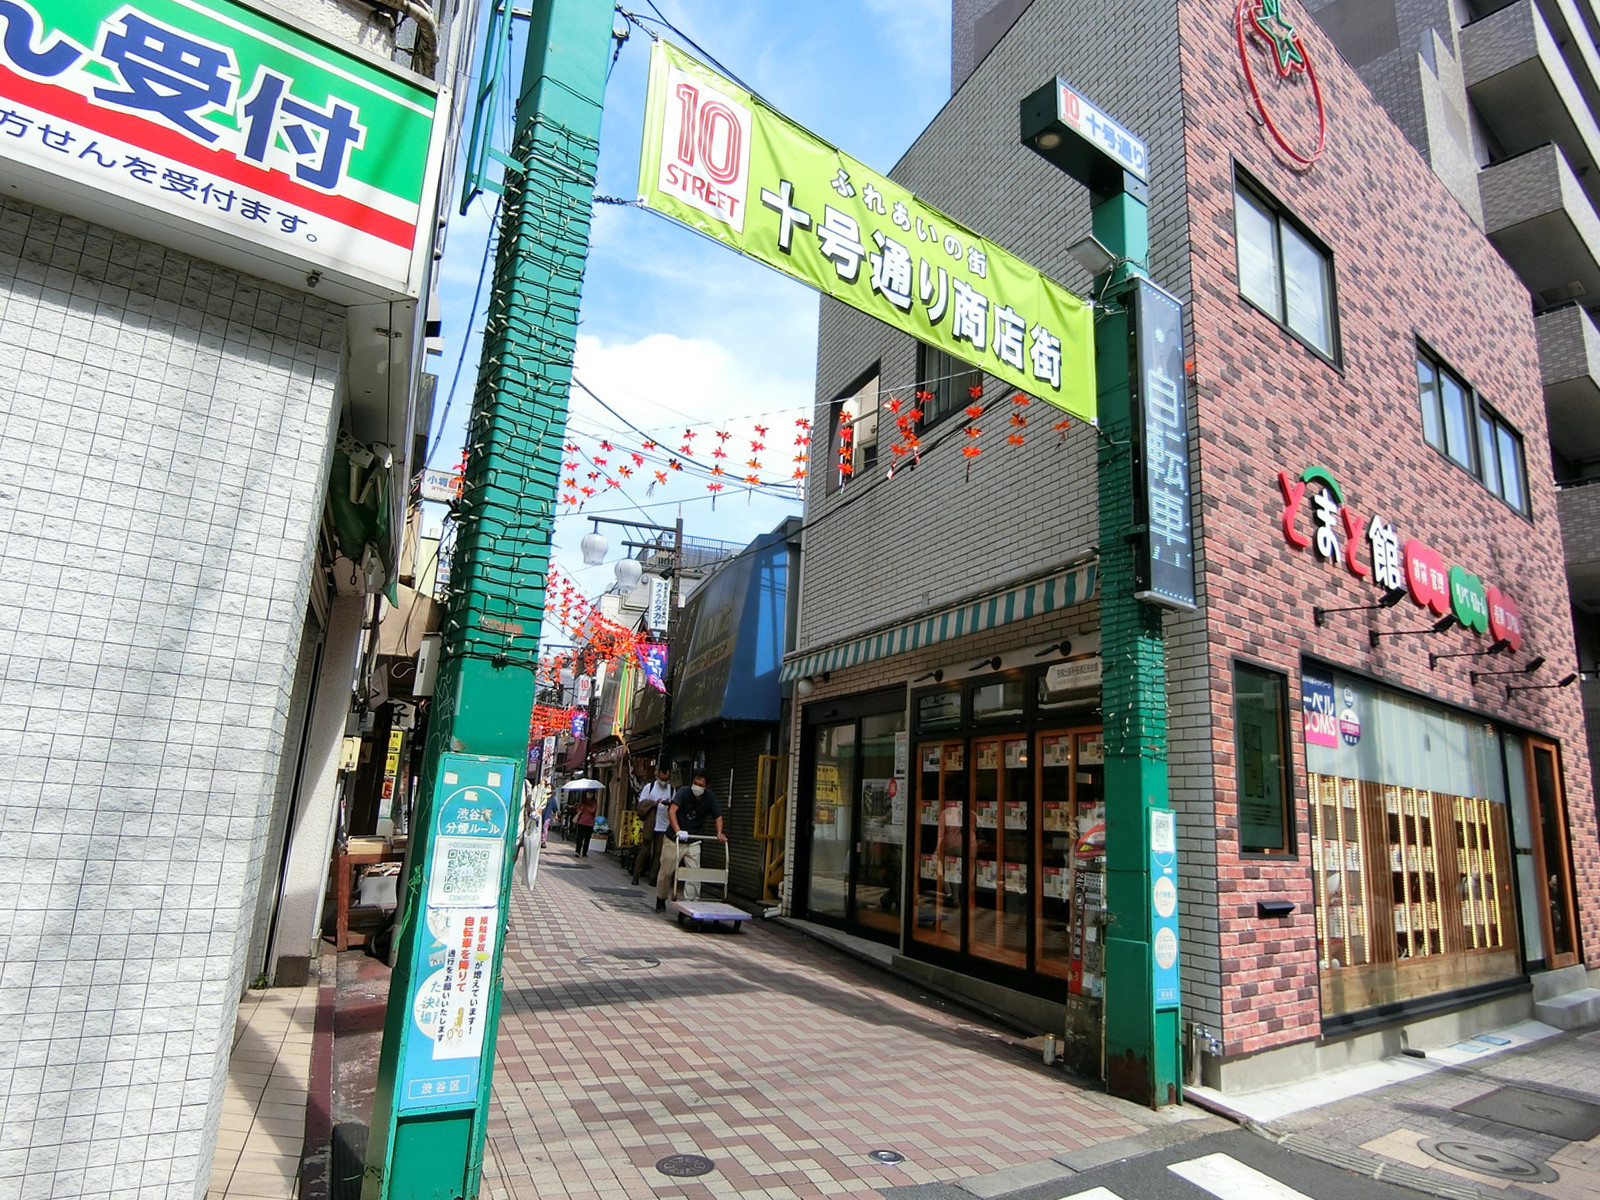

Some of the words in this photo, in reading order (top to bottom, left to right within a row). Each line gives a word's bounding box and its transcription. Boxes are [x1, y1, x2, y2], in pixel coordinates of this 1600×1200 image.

[675, 81, 743, 186] 10
[1063, 88, 1080, 120] 10
[1086, 113, 1144, 169] 十号通り
[0, 109, 318, 243] 方せんを受付ます。
[666, 162, 741, 221] STREET
[830, 167, 988, 280] ふれあいの街
[759, 178, 1063, 391] 十号通り商店街
[1146, 367, 1188, 567] 自転車
[1278, 471, 1401, 590] とまと館
[446, 822, 500, 835] 分煙ルール
[437, 949, 456, 1043] 通行をお願いいたします
[457, 916, 475, 993] 自転車を降りて
[421, 1079, 461, 1095] 渋谷区
